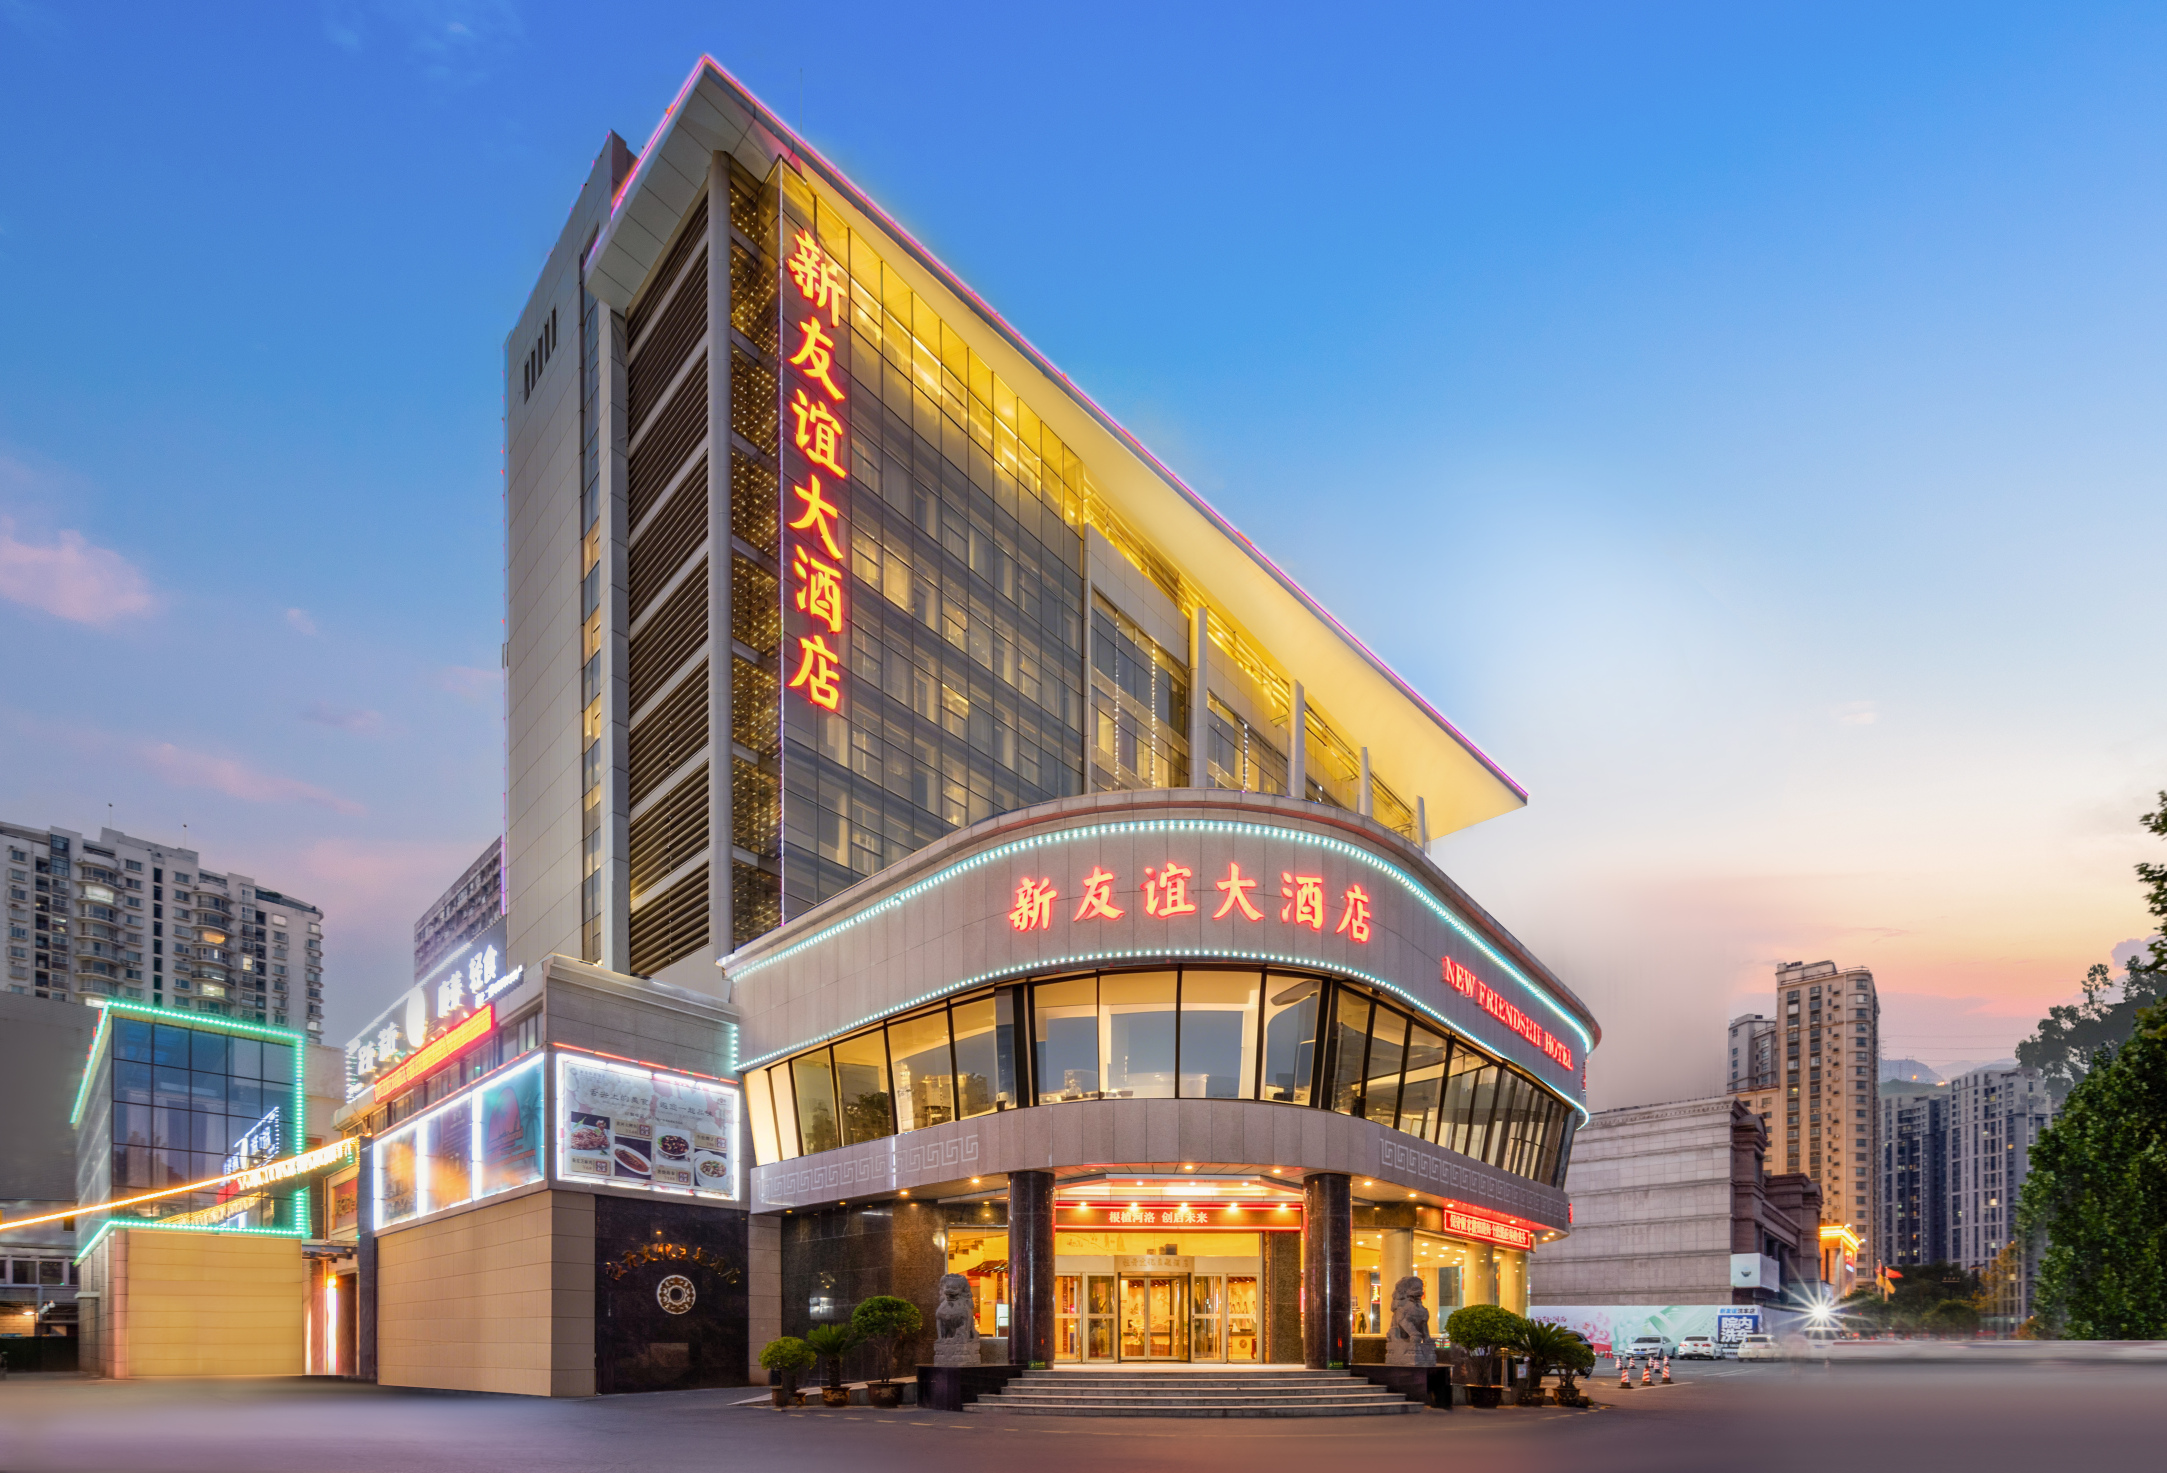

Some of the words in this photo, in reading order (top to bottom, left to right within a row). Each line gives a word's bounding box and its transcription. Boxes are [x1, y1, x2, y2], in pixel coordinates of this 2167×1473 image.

[785, 228, 847, 713] 新友谊大酒店
[1008, 862, 1373, 944] 新友谊大酒店
[1442, 955, 1477, 998] NEW
[1544, 1031, 1574, 1072] HOTEL
[1109, 1211, 1155, 1224] 根植河洛
[1161, 1211, 1208, 1224] 创启未来
[1721, 1317, 1753, 1329] 院内
